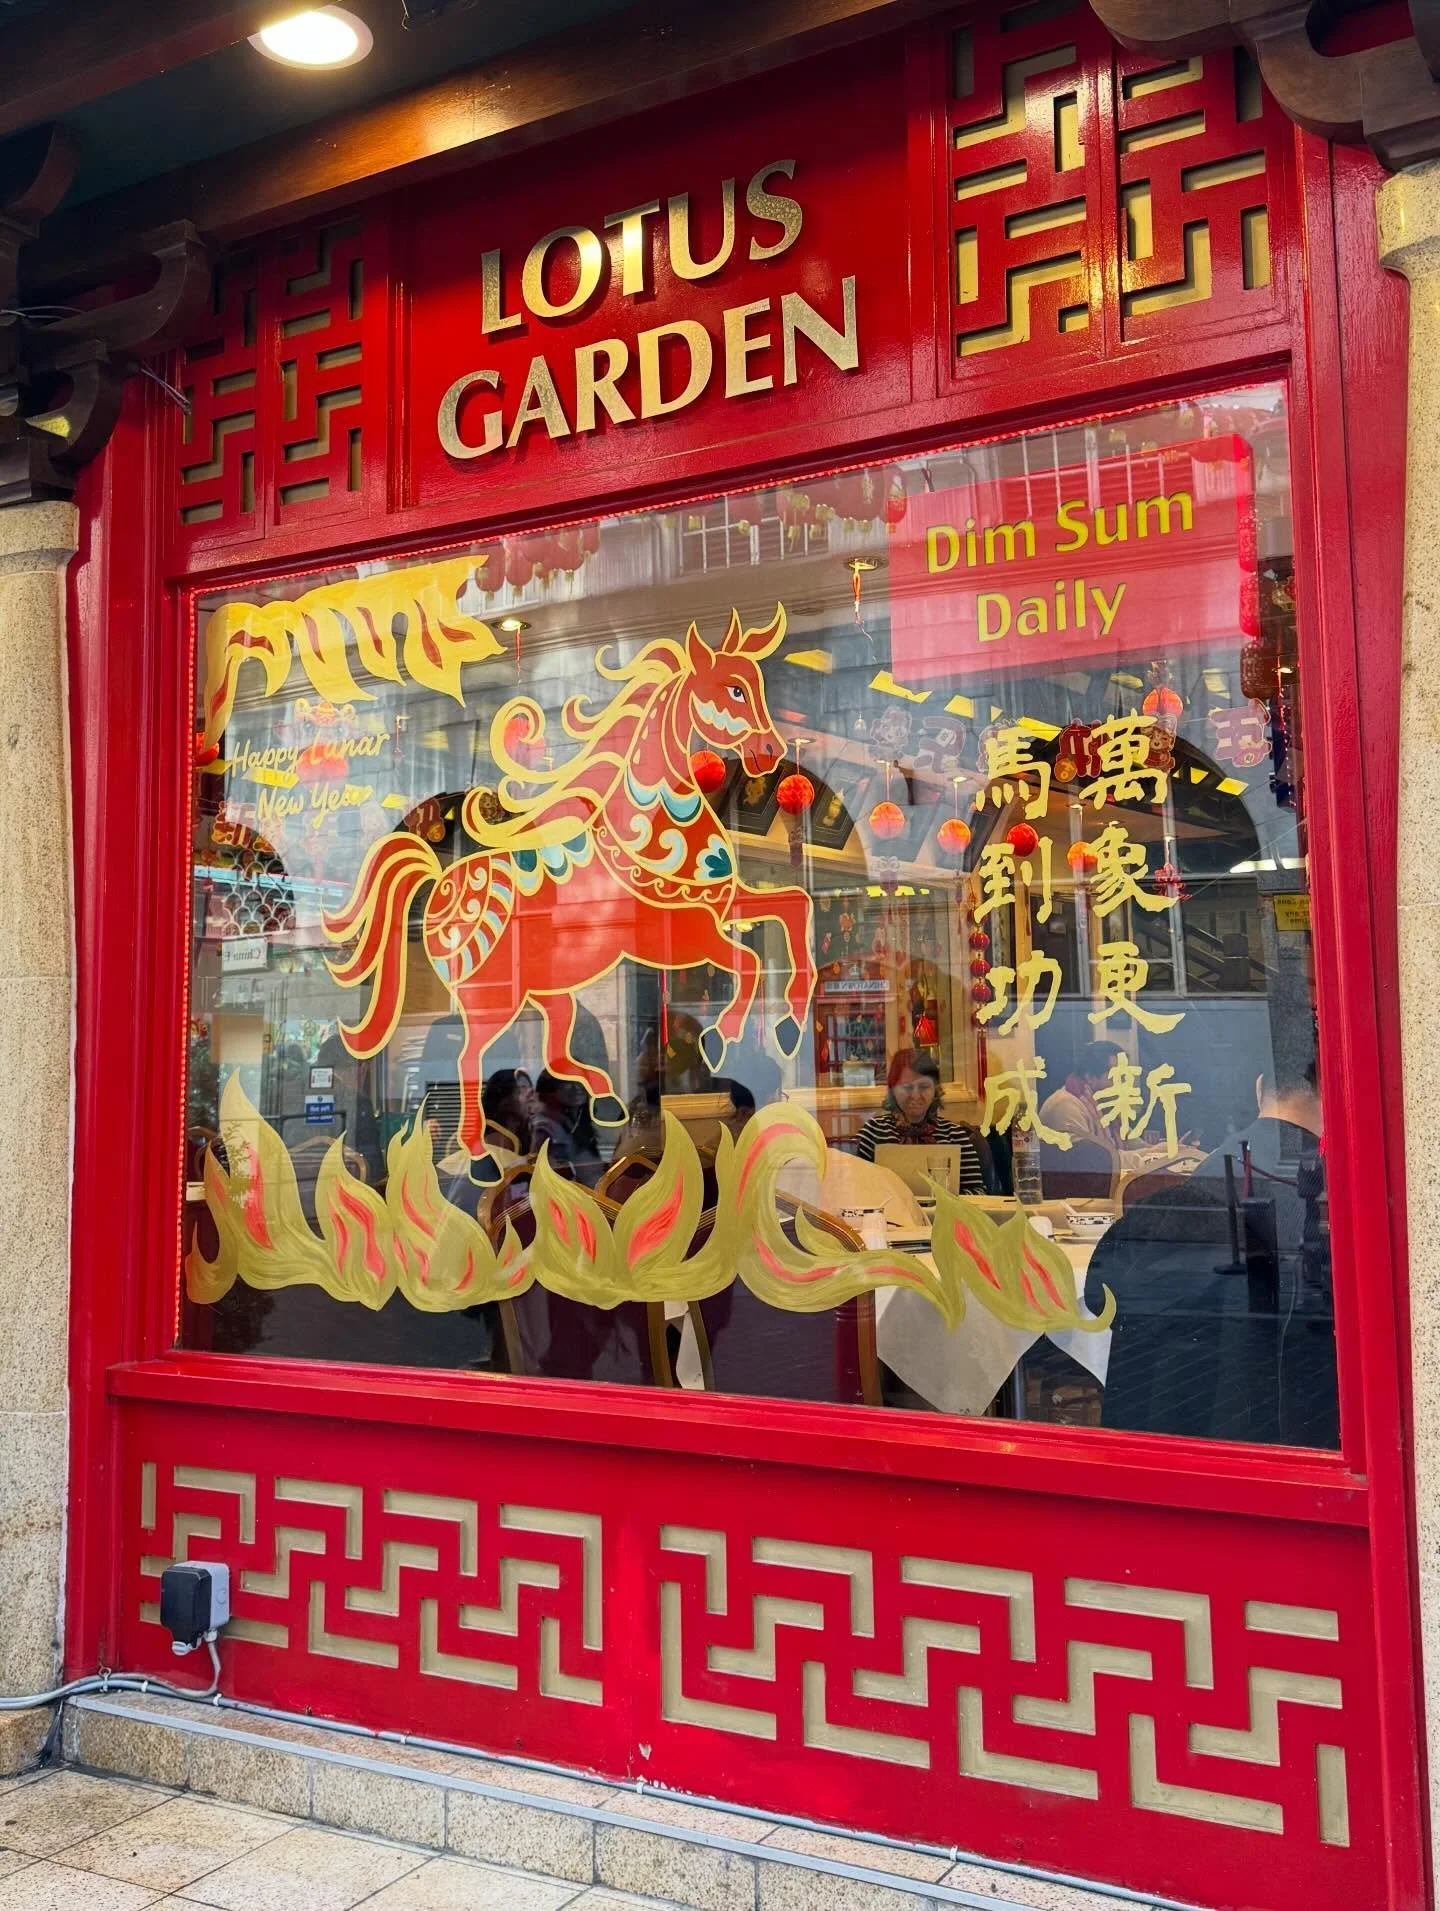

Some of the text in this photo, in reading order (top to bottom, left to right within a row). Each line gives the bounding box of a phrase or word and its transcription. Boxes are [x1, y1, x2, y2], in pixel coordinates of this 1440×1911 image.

[480, 159, 803, 335] LOTUS
[437, 275, 859, 460] GARDEN
[926, 491, 1194, 574] Dim Sum
[976, 578, 1127, 642] Daily
[230, 731, 391, 779] Happy Lunar
[257, 783, 374, 830] New Year
[975, 727, 1074, 1151] 馬到功成
[1079, 708, 1192, 1159] 萬象更新
